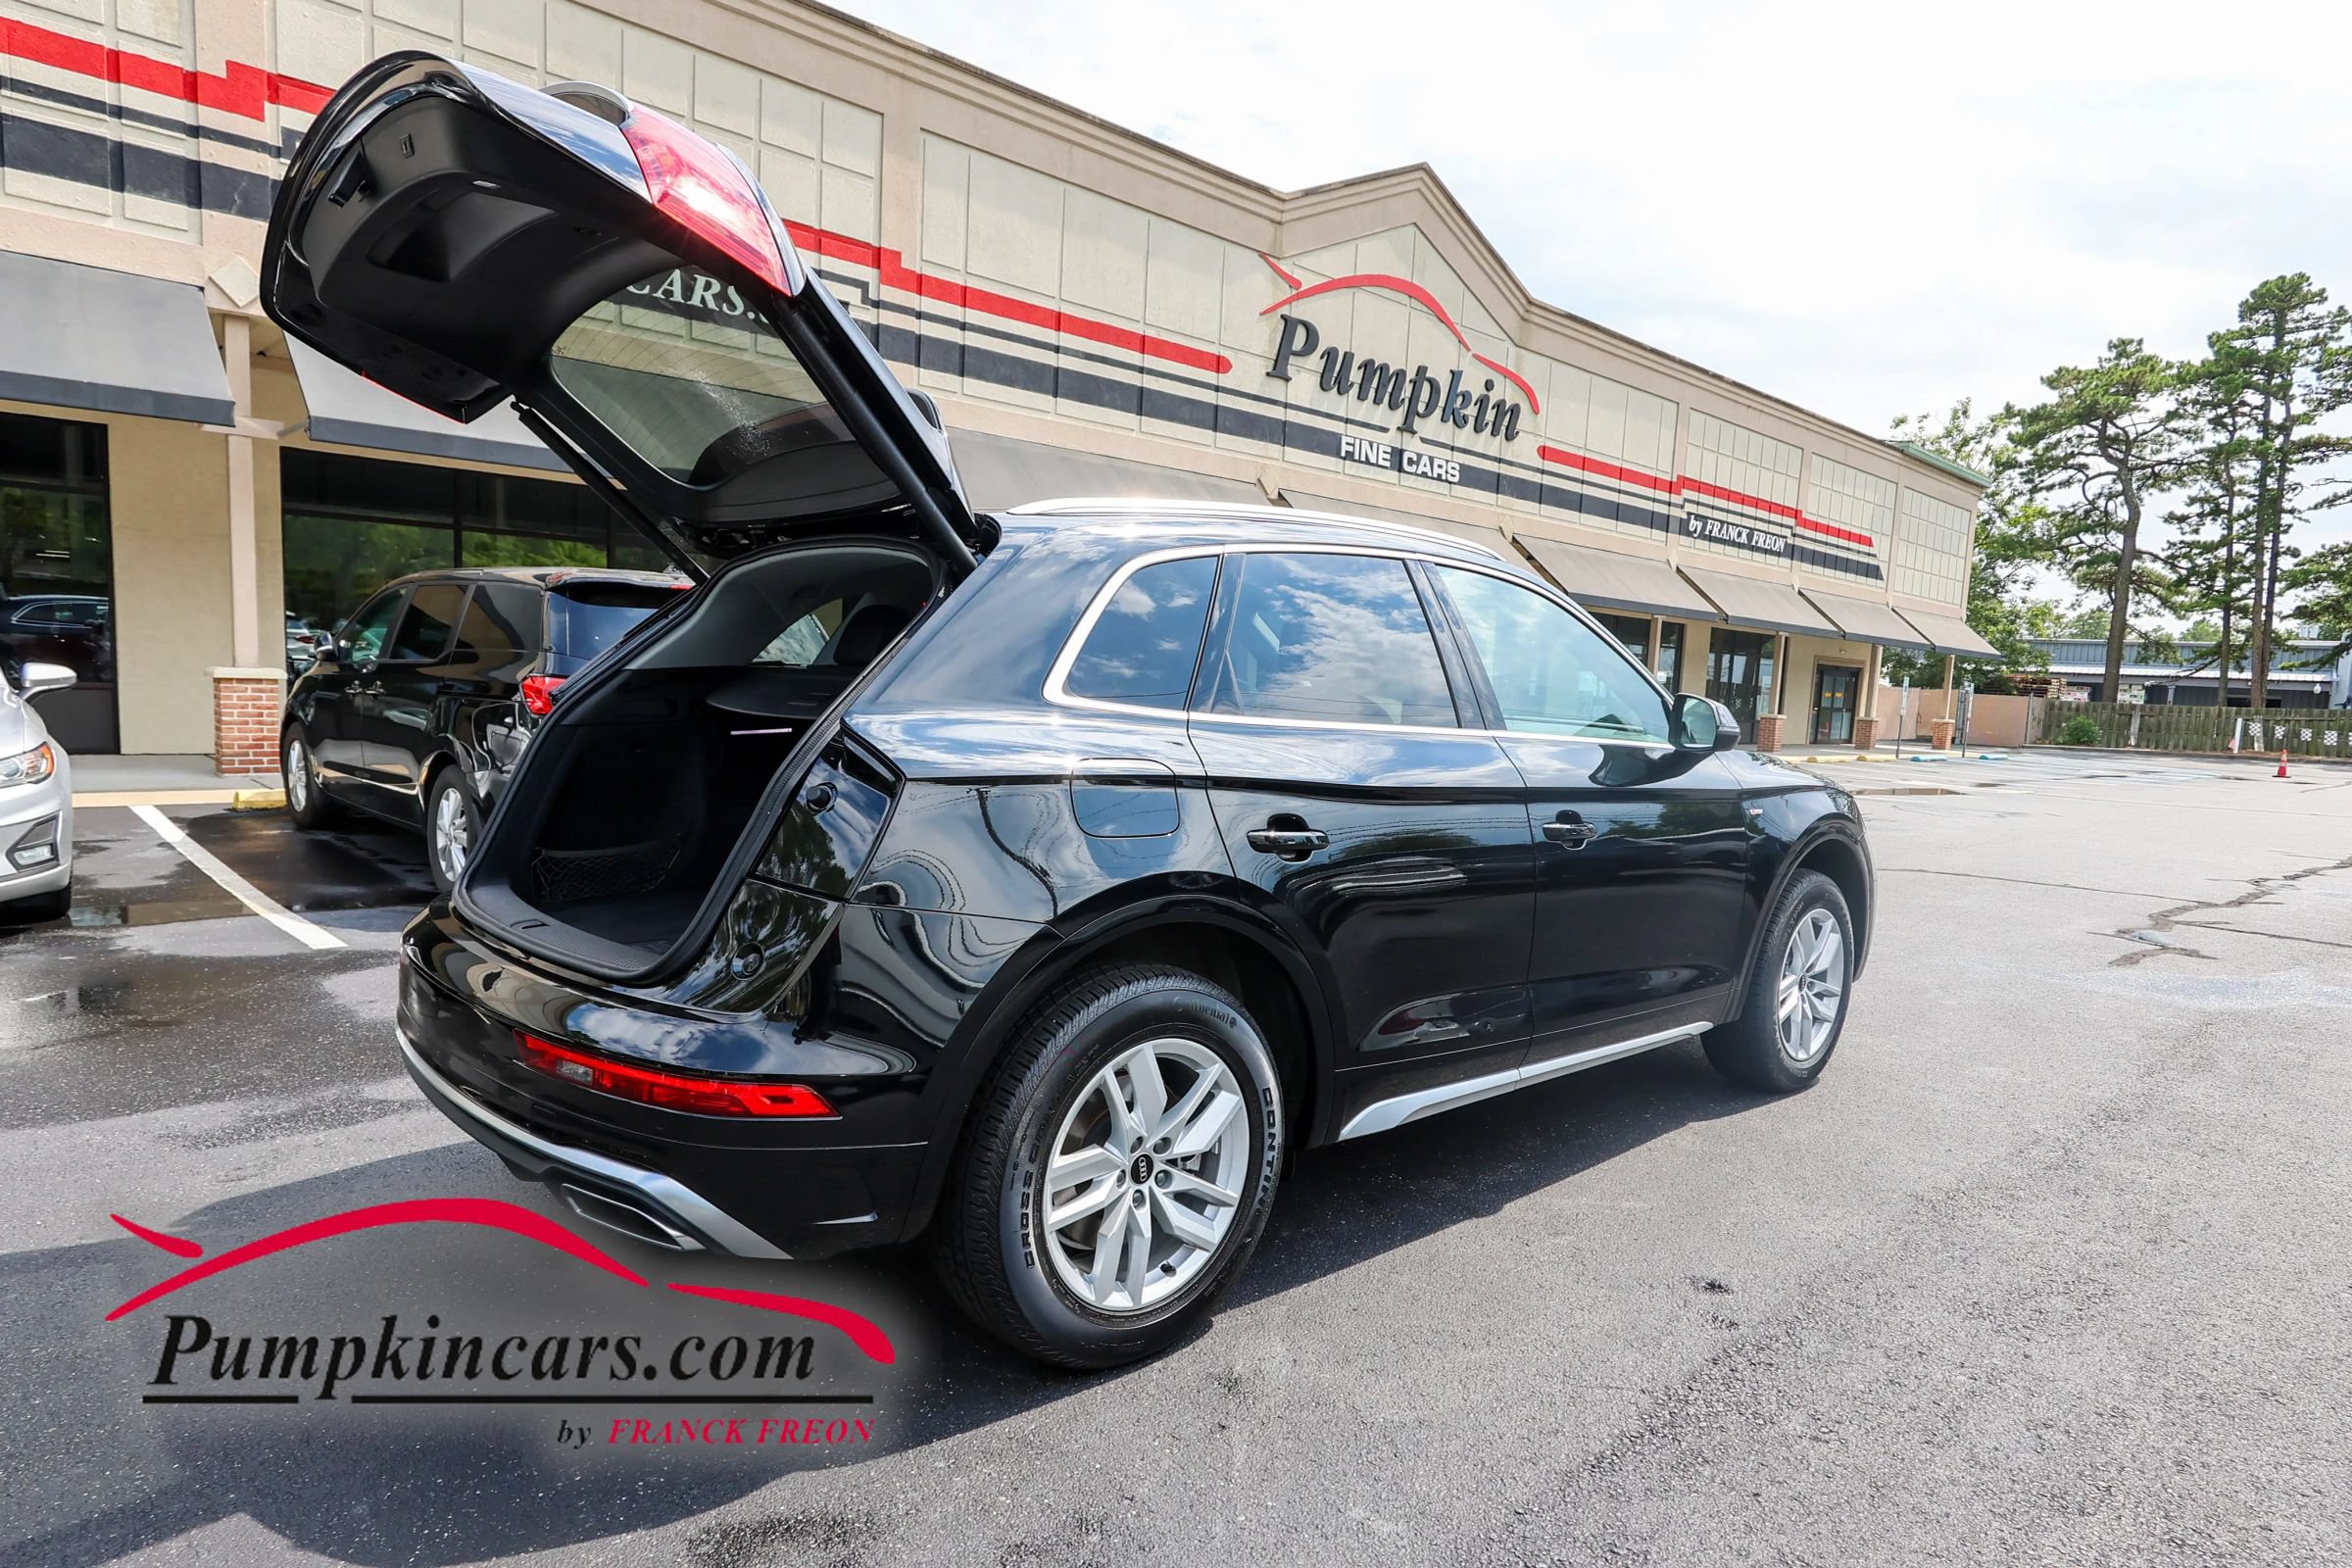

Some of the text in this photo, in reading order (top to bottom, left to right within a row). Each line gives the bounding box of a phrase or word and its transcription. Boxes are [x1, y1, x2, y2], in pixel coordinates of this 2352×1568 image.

[625, 269, 769, 325] ARS.
[1266, 314, 1521, 441] Pumpkin
[1340, 435, 1460, 482] FINE CARS
[1689, 514, 1786, 553] by FRANCK FREON
